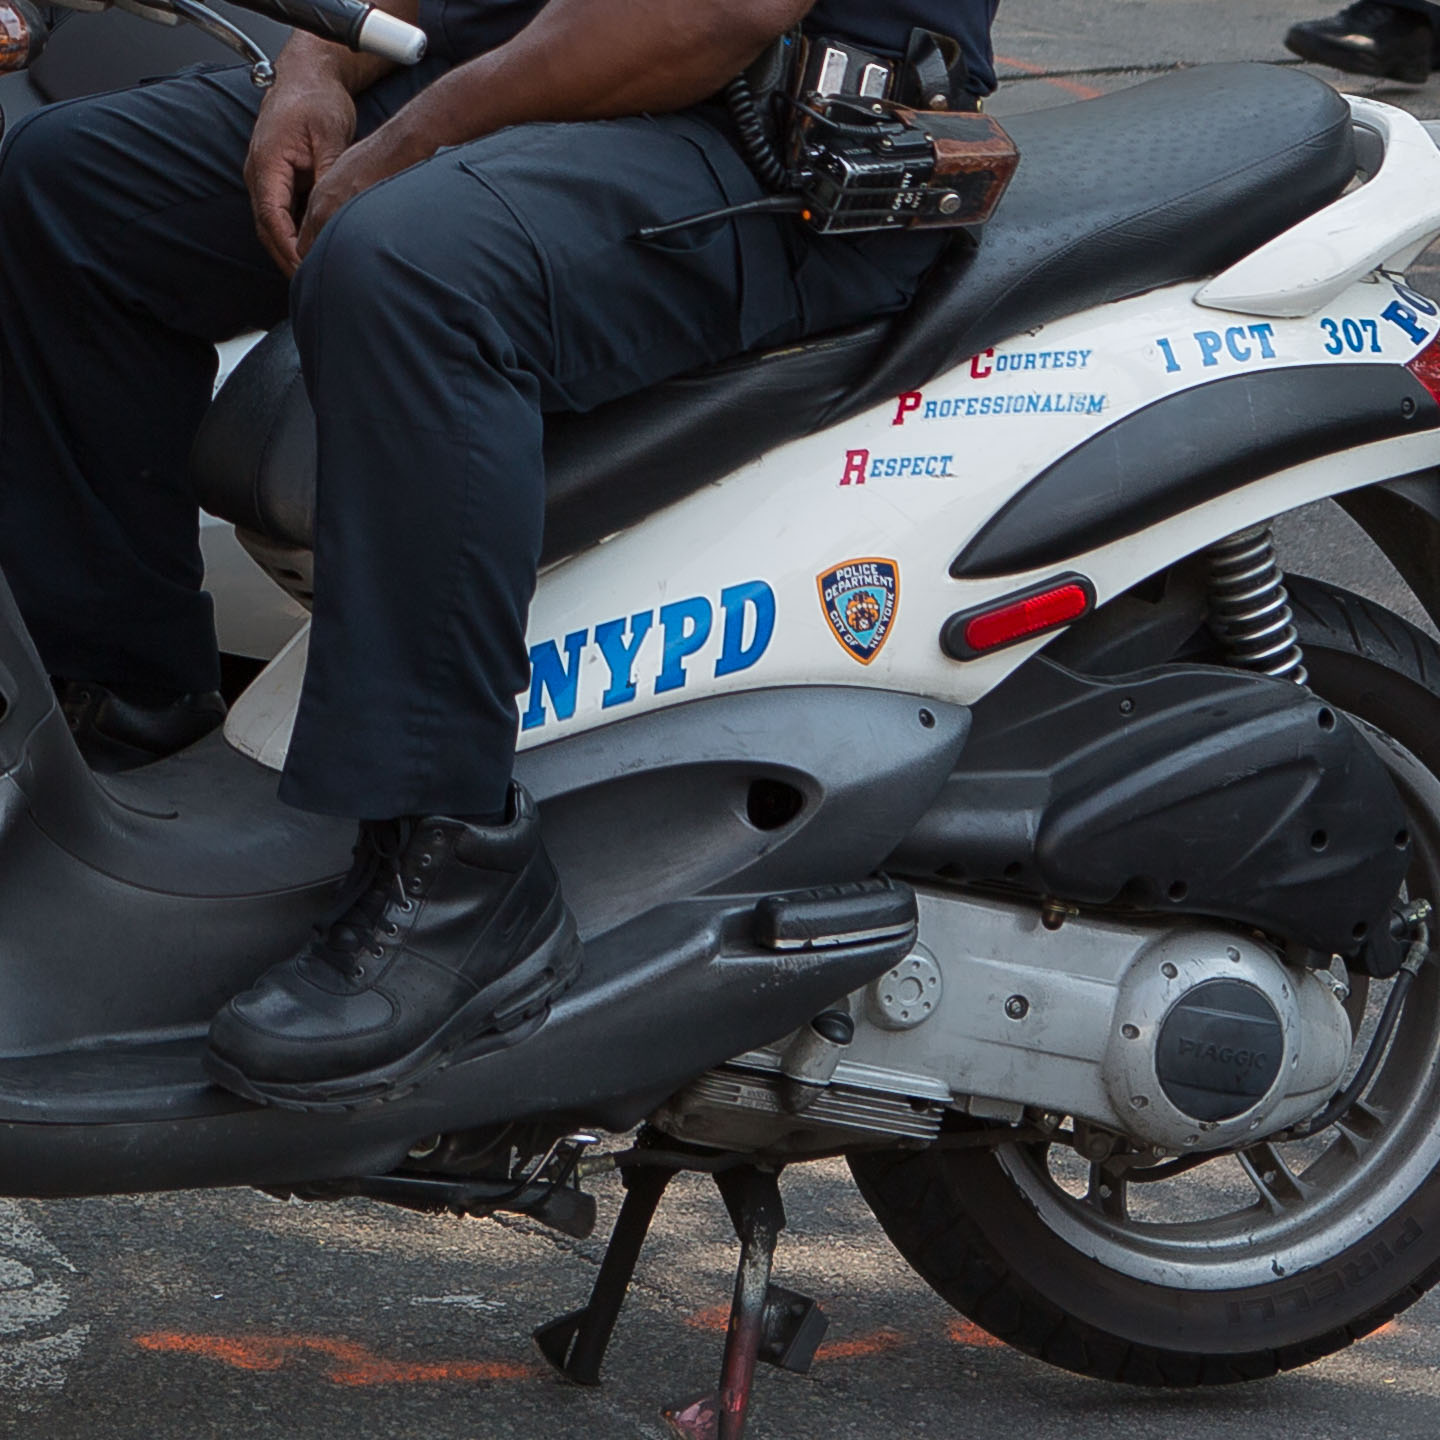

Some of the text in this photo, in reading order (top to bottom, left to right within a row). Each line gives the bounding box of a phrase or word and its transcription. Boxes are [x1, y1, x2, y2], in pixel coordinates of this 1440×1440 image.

[1156, 317, 1382, 373] 1 PCT 307
[970, 347, 1092, 379] COURTESY
[892, 391, 1106, 426] PROFESSIONALISM
[840, 449, 954, 486] RESPECT
[825, 575, 893, 601] DEPARTMENT
[836, 564, 878, 581] POLICE
[830, 610, 858, 645] CITY OF
[870, 592, 894, 648] NEW YORK
[521, 580, 777, 732] NYPD
